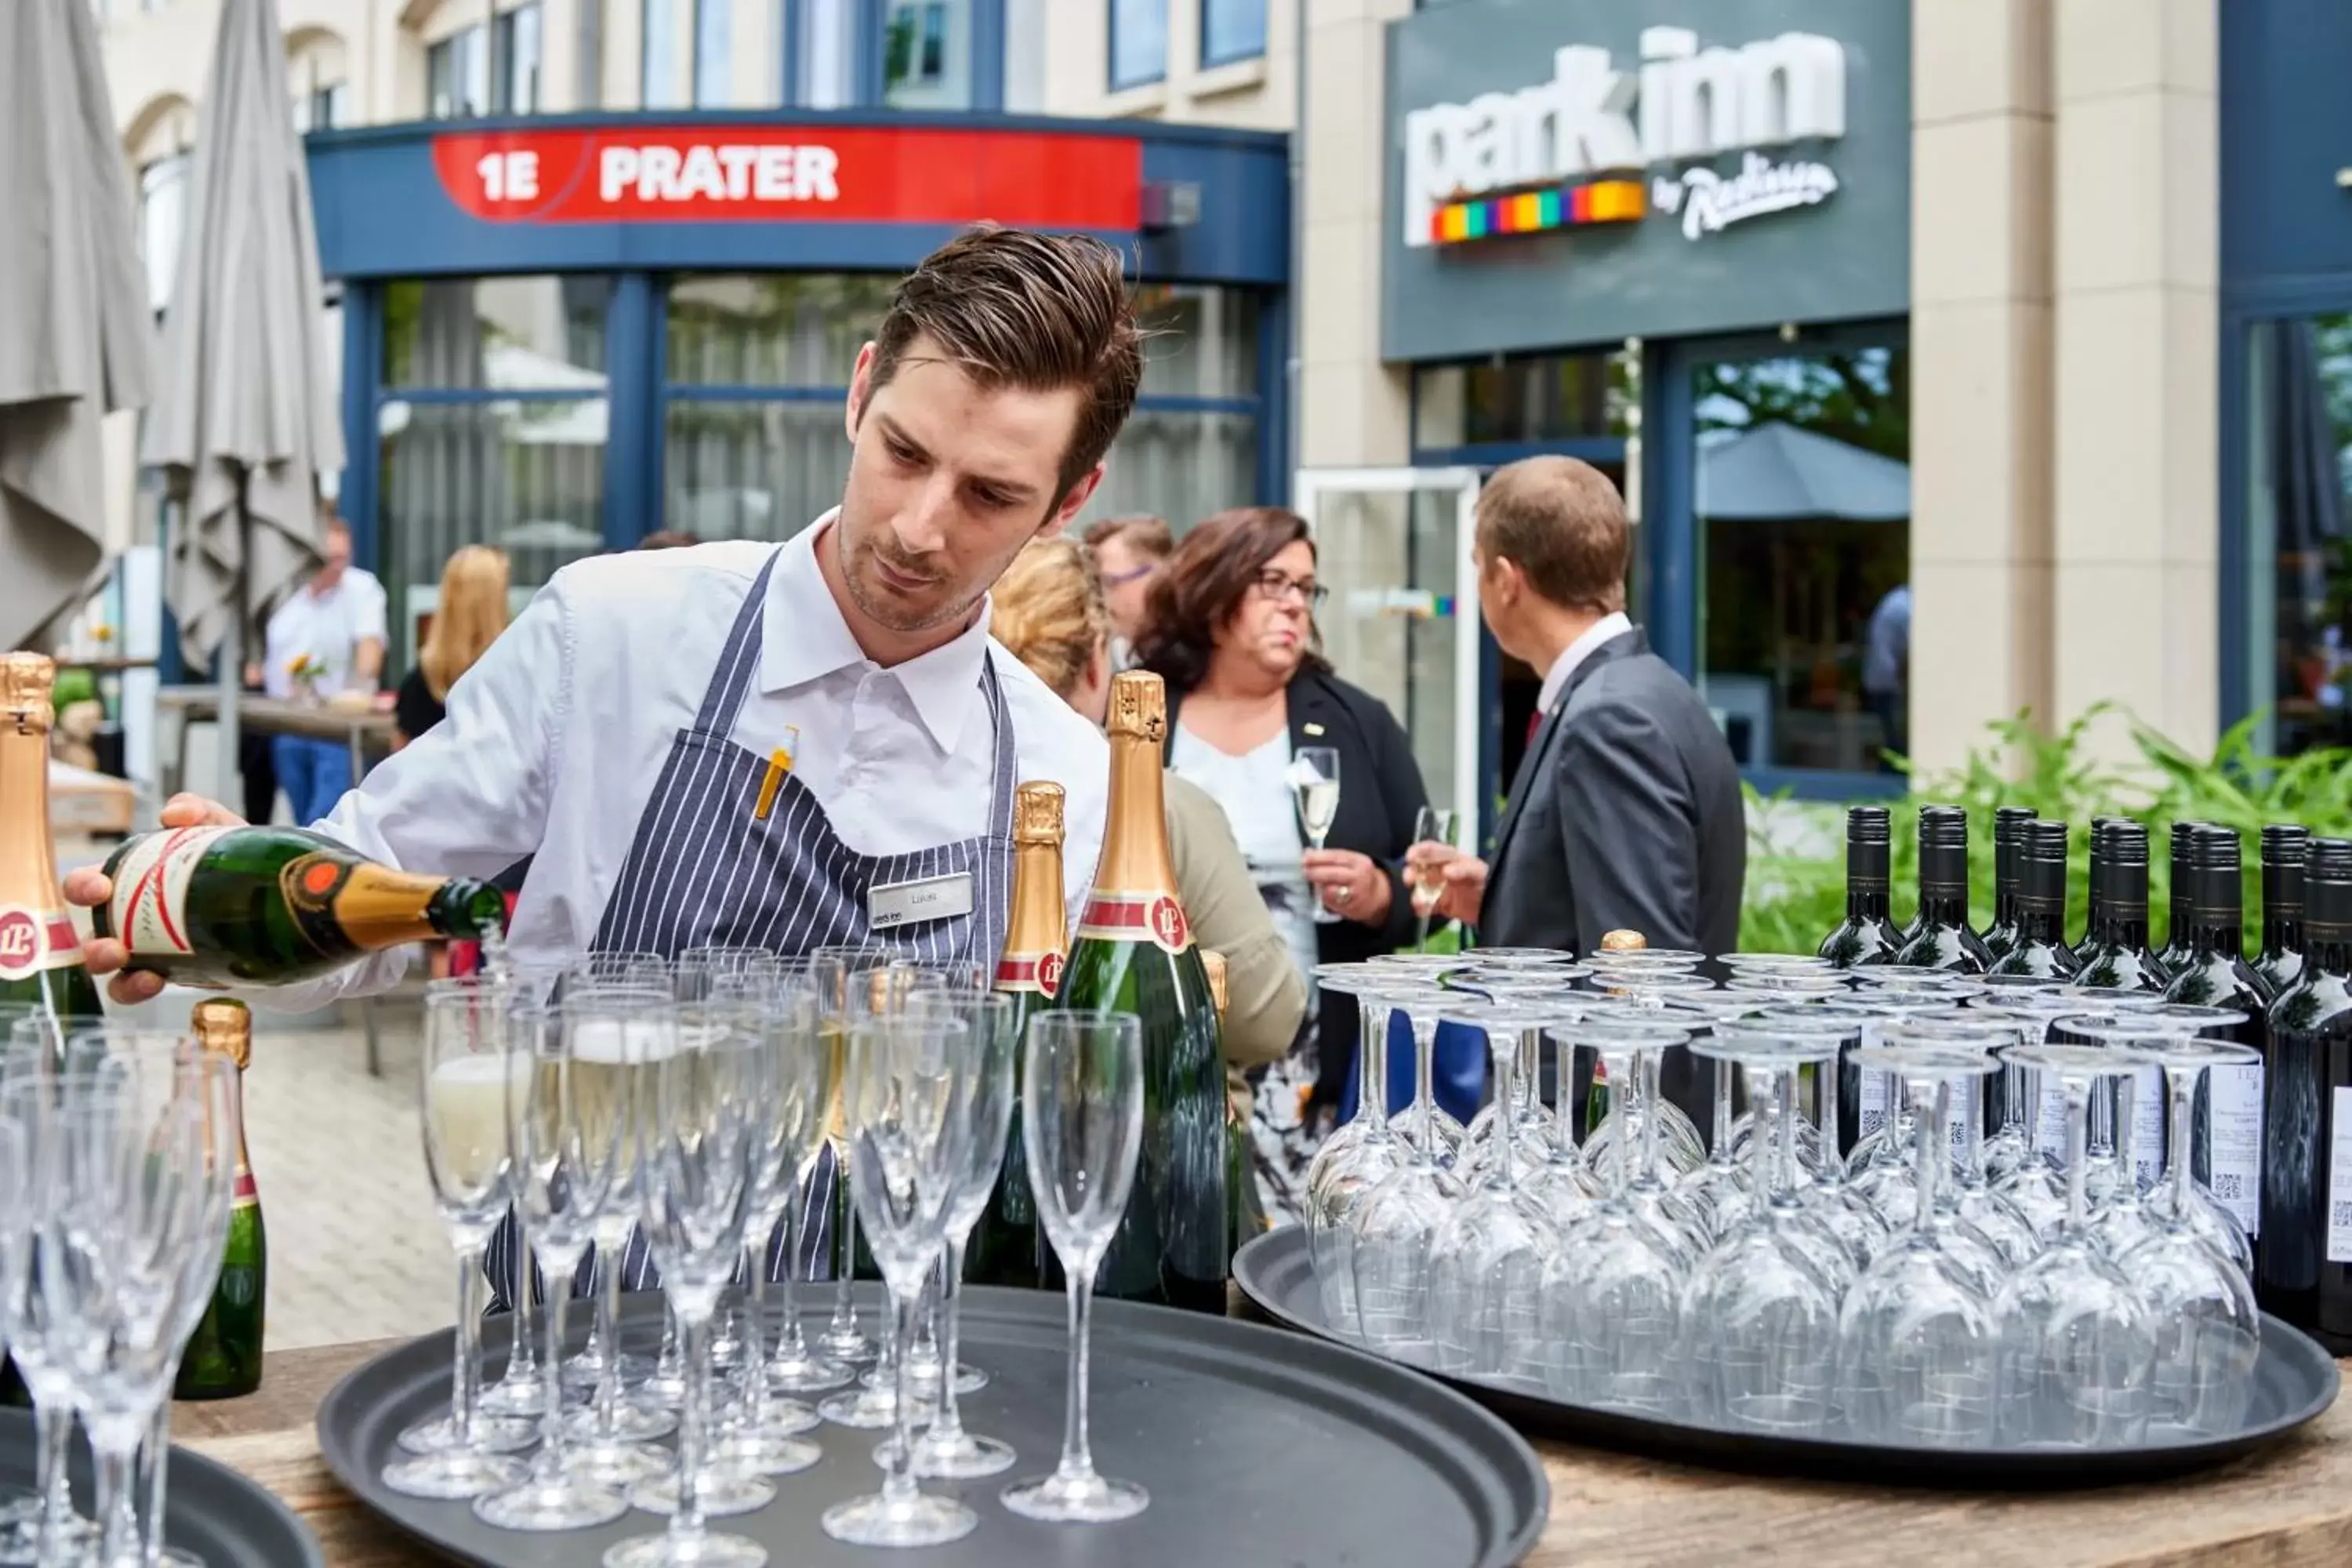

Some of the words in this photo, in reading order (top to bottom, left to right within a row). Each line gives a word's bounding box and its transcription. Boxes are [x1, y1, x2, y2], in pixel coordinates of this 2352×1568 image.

[1404, 44, 1642, 248] park
[1639, 24, 1846, 162] inn
[477, 151, 540, 201] 1E
[599, 144, 840, 202] PRATER
[1652, 176, 1683, 214] by
